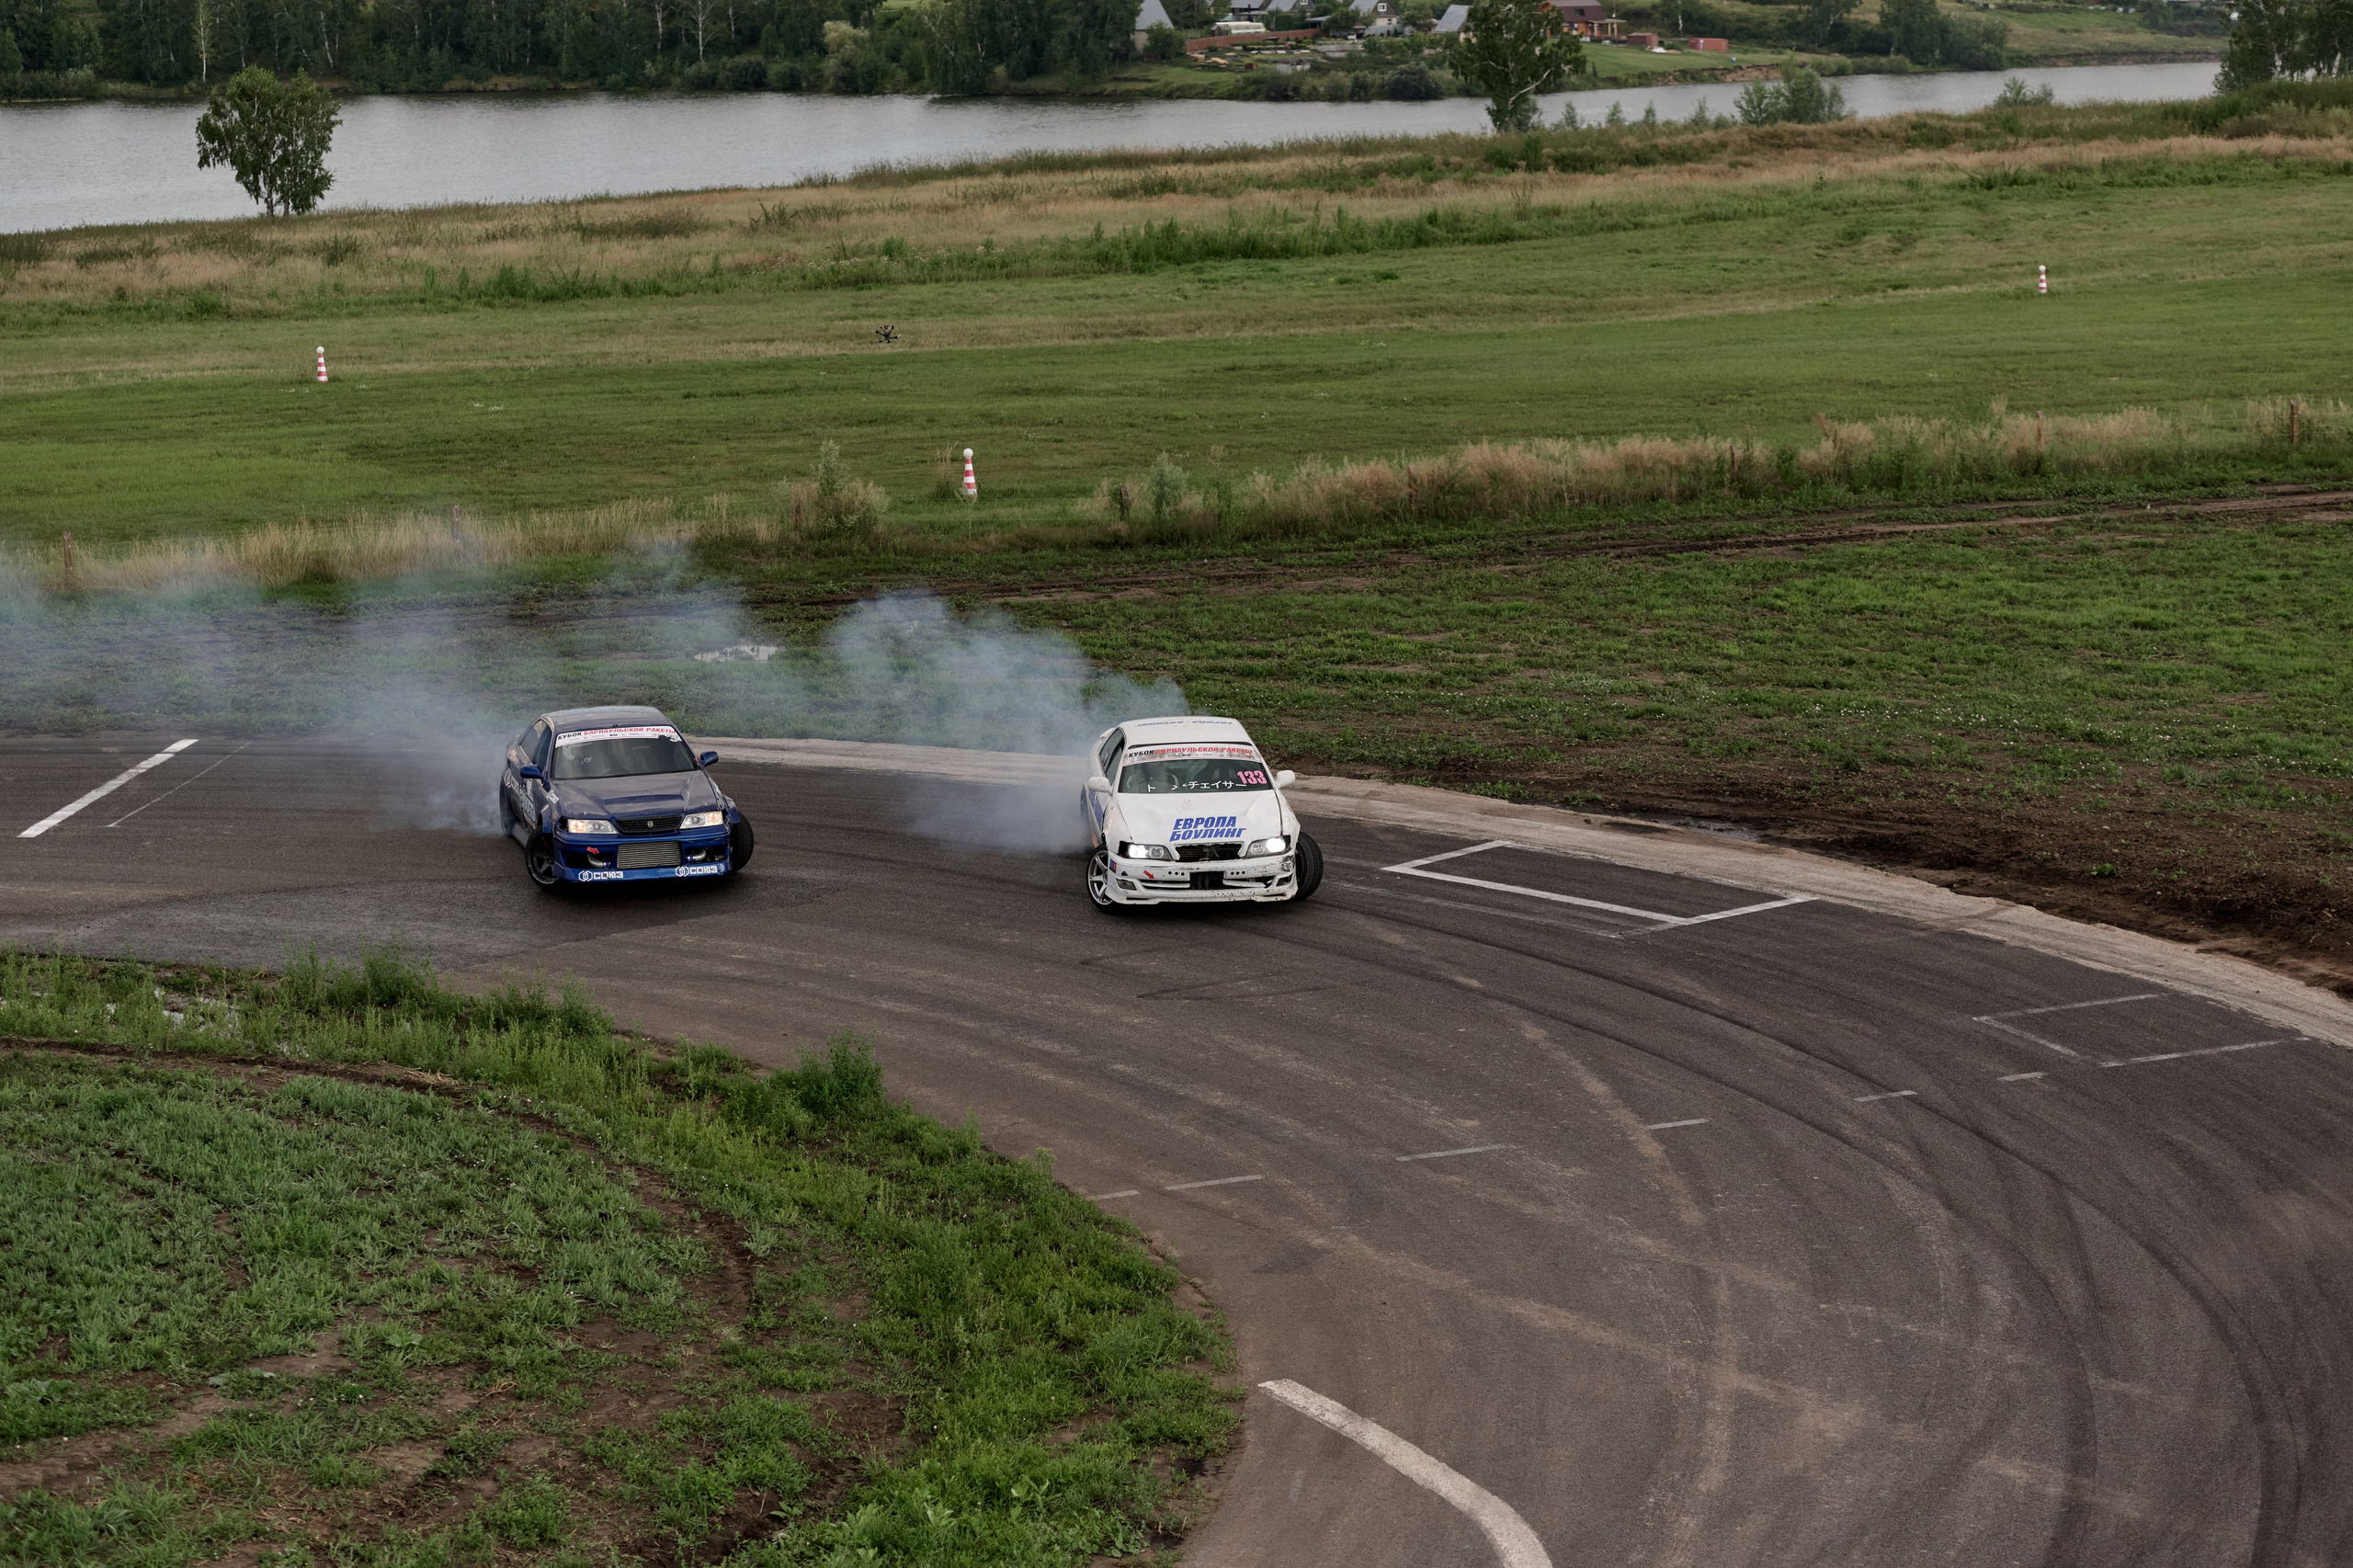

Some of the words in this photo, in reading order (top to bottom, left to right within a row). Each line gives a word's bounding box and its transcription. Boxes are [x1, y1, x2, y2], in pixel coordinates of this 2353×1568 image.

[558, 732, 582, 741] КУБОК
[584, 727, 643, 735] БАРНАУЛЬСКОЙ
[1128, 749, 1154, 758] КУБОК
[1155, 746, 1219, 755] БАРНАУЛЬСКОЙ
[1221, 746, 1253, 755] РАКЕТЫ
[1237, 770, 1267, 785] 133
[1173, 816, 1236, 830] ЕВРОПА
[1169, 828, 1246, 842] БОУЛИНГ
[593, 870, 624, 880] СОЮЗ
[690, 865, 718, 874] СОЮЗ
